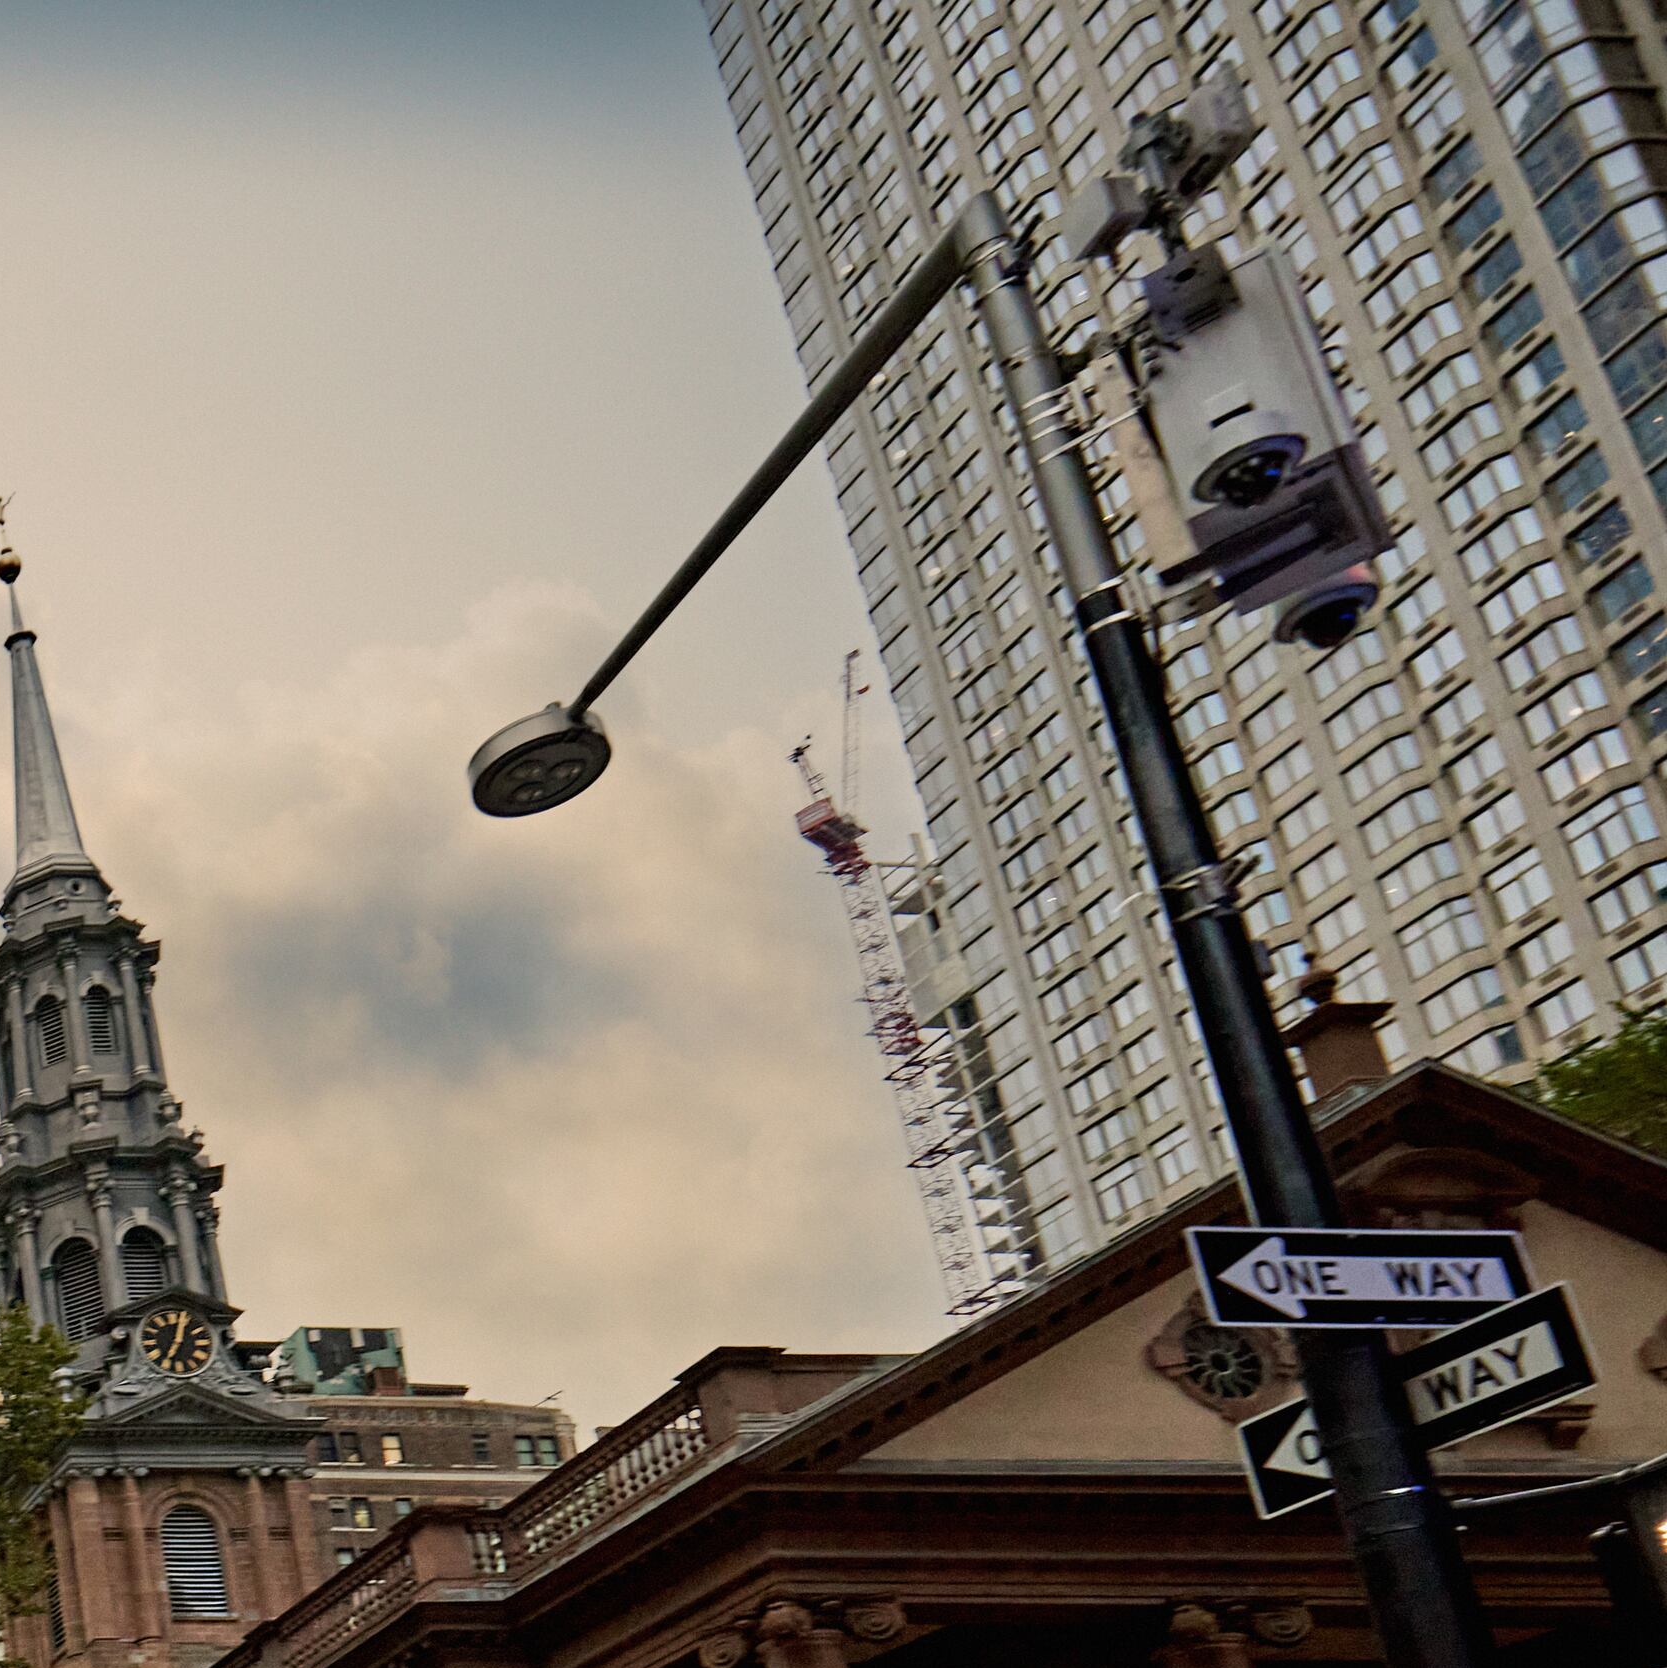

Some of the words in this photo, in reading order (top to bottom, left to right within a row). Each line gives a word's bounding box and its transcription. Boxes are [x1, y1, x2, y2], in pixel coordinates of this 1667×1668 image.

[1251, 1259, 1347, 1296] ONE
[1385, 1261, 1485, 1298] WAY
[1422, 1336, 1531, 1412] WAY
